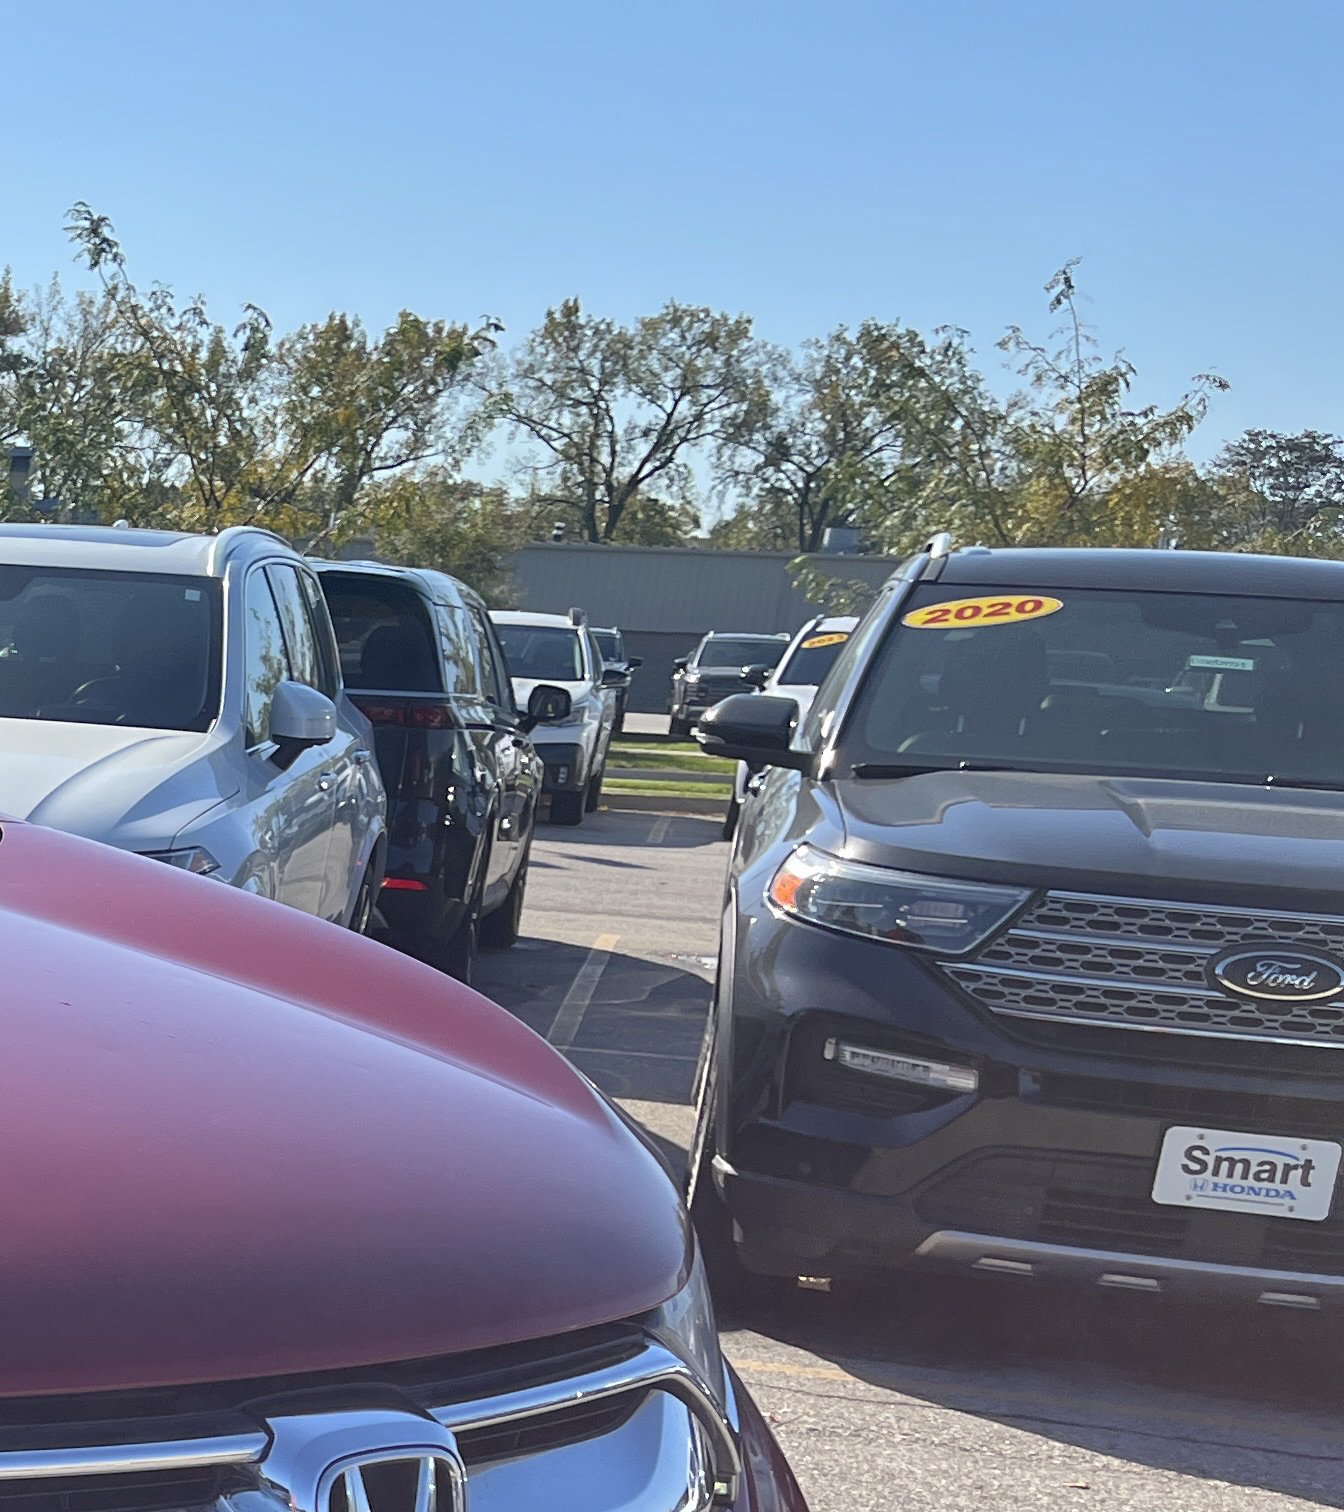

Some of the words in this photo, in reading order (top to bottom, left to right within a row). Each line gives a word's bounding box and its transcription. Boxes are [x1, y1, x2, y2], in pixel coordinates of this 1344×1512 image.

[921, 599, 1043, 625] 2020
[1246, 960, 1317, 990] Ford
[1180, 1144, 1316, 1188] Smart
[1211, 1181, 1297, 1201] HONDA
